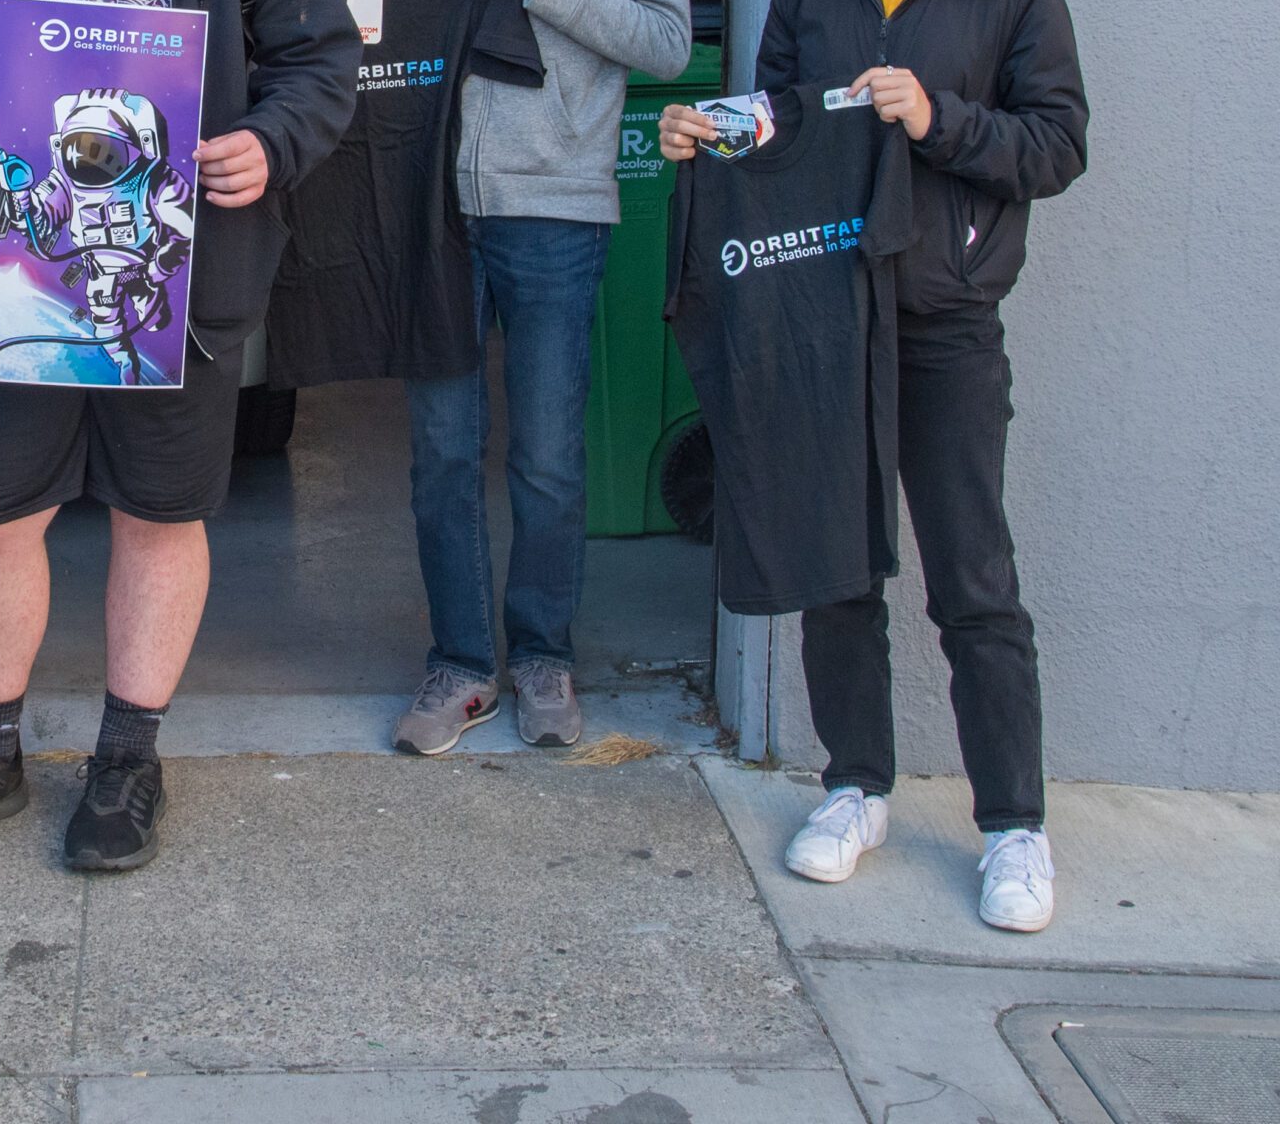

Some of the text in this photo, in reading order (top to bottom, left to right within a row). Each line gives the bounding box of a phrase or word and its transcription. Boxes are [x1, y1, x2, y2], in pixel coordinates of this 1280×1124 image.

[74, 40, 94, 50] Gas
[95, 42, 138, 54] Stations
[140, 46, 149, 55] in
[358, 58, 444, 79] RBITFAB
[366, 78, 406, 90] Stations
[407, 75, 417, 86] in
[621, 112, 663, 122] OSTABL
[615, 157, 665, 171] ecology
[753, 255, 776, 268] Gas
[778, 244, 824, 263] Stations
[826, 240, 838, 253] in
